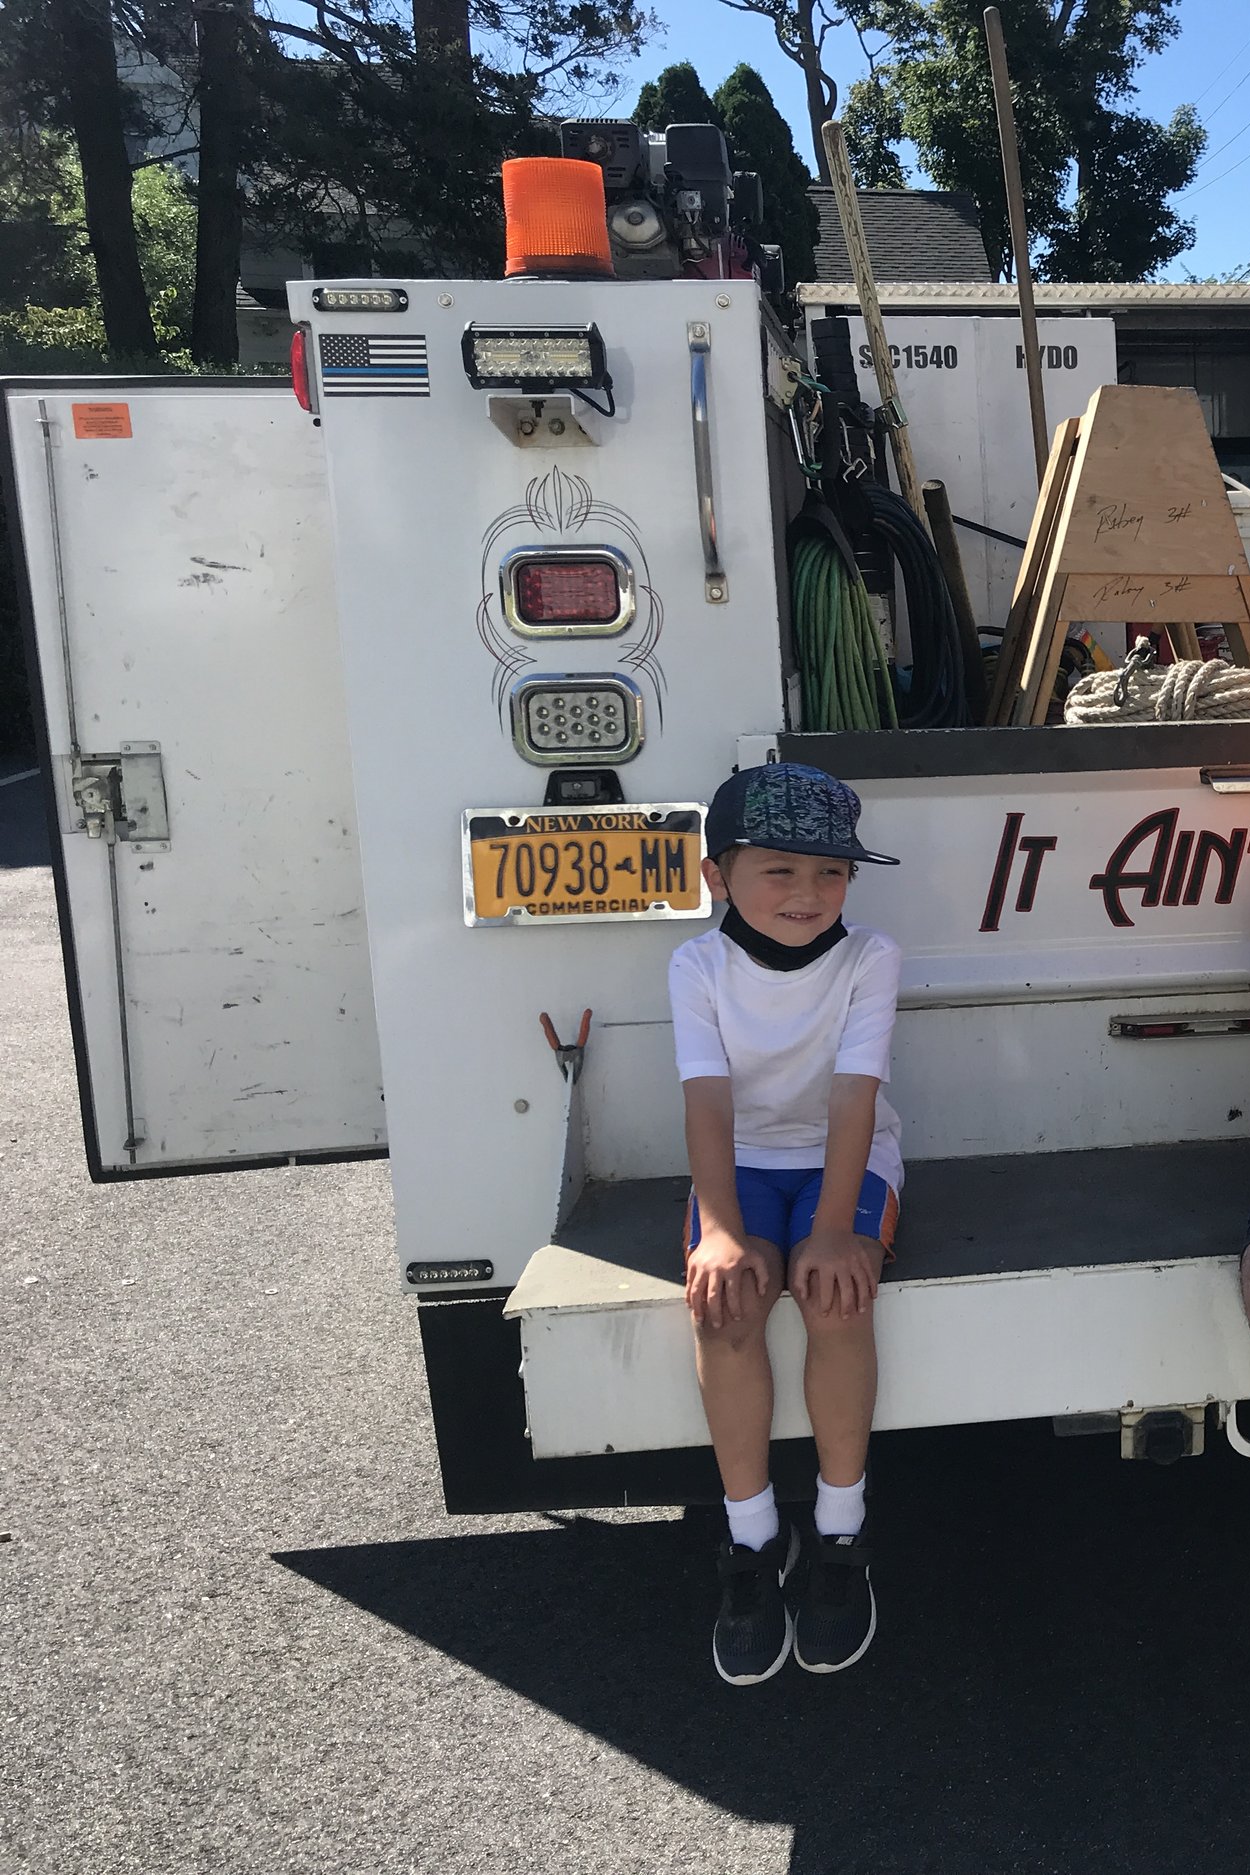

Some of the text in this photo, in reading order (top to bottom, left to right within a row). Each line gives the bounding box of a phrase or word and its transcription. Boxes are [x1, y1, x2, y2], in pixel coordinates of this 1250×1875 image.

[858, 344, 959, 369] SC1540
[525, 813, 649, 833] NEW YORK
[489, 840, 609, 899] 70938
[526, 898, 649, 916] COMMERCIAL
